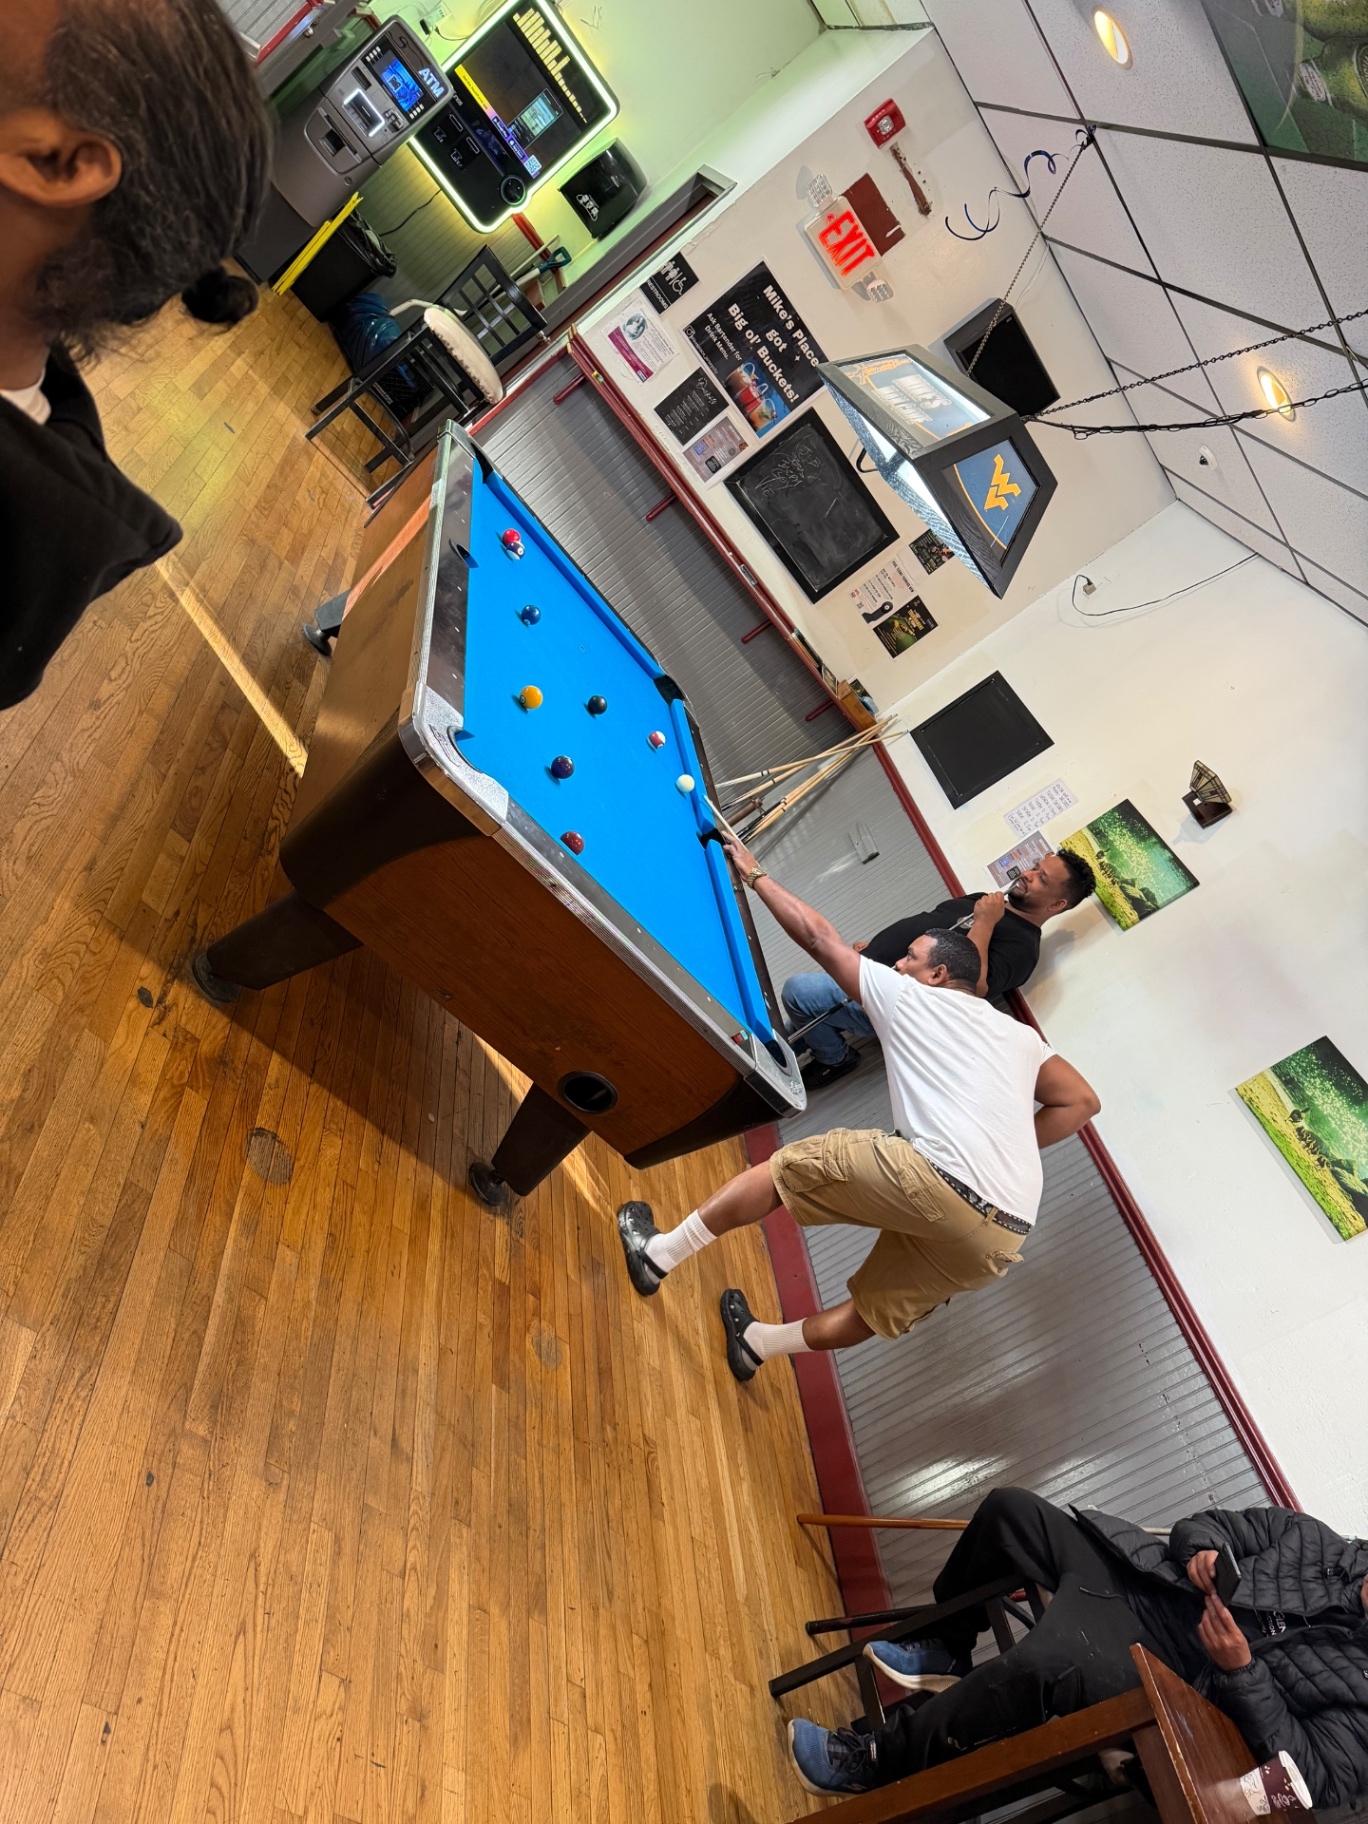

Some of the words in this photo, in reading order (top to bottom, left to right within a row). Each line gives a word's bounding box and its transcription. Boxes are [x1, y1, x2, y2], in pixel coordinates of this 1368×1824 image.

[418, 69, 444, 96] ATM
[818, 212, 875, 276] EXIT
[703, 324, 718, 342] Drink
[714, 340, 731, 360] Menu.
[706, 311, 717, 324] Ask
[714, 322, 736, 352] Bartender
[733, 350, 743, 361] for
[763, 285, 797, 330] Mike's
[792, 329, 821, 367] Place
[766, 328, 788, 352] got
[727, 303, 749, 331] Big
[757, 346, 799, 402] Buckets!
